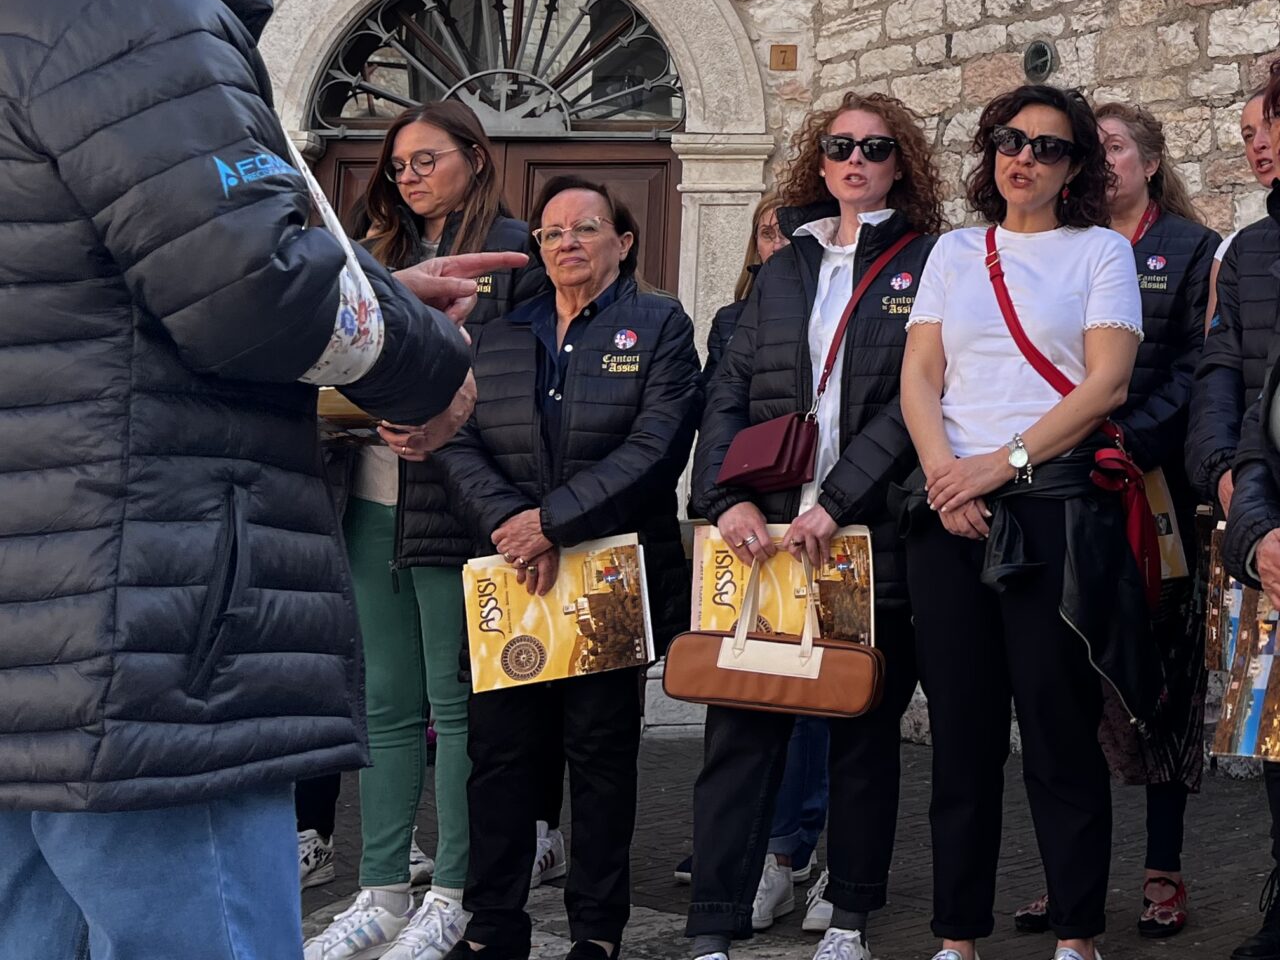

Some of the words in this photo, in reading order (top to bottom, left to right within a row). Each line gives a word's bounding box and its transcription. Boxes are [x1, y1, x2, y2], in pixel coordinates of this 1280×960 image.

[780, 50, 787, 65] 7
[888, 304, 911, 313] Assi
[602, 354, 640, 363] Cantori
[608, 362, 640, 372] Assisi
[712, 549, 737, 615] ASSISI
[476, 577, 506, 639] ASSISI
